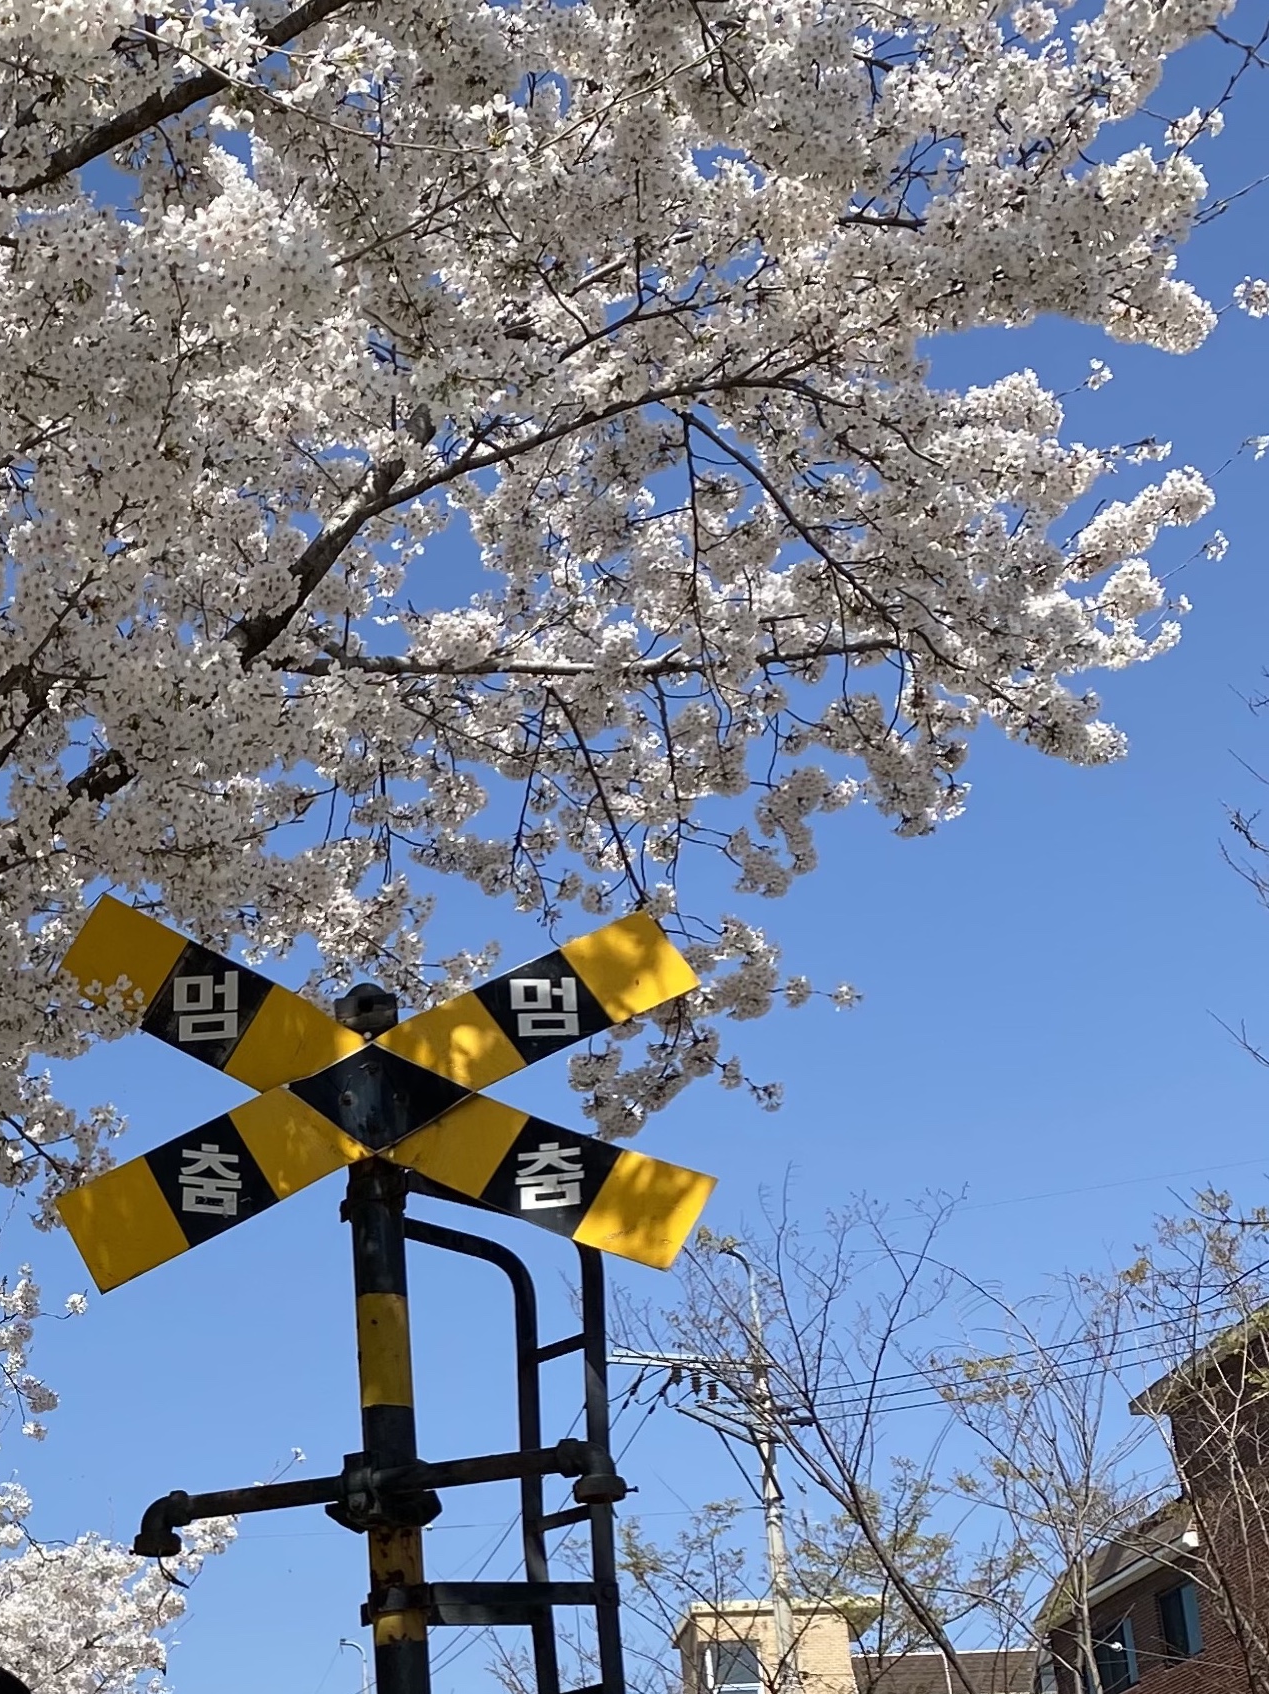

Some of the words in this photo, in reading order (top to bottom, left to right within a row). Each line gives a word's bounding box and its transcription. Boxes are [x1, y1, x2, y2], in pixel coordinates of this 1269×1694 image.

[172, 970, 240, 1042] 멈
[509, 975, 580, 1037] 멈
[177, 1143, 243, 1217] 춤
[515, 1142, 586, 1211] 춤
